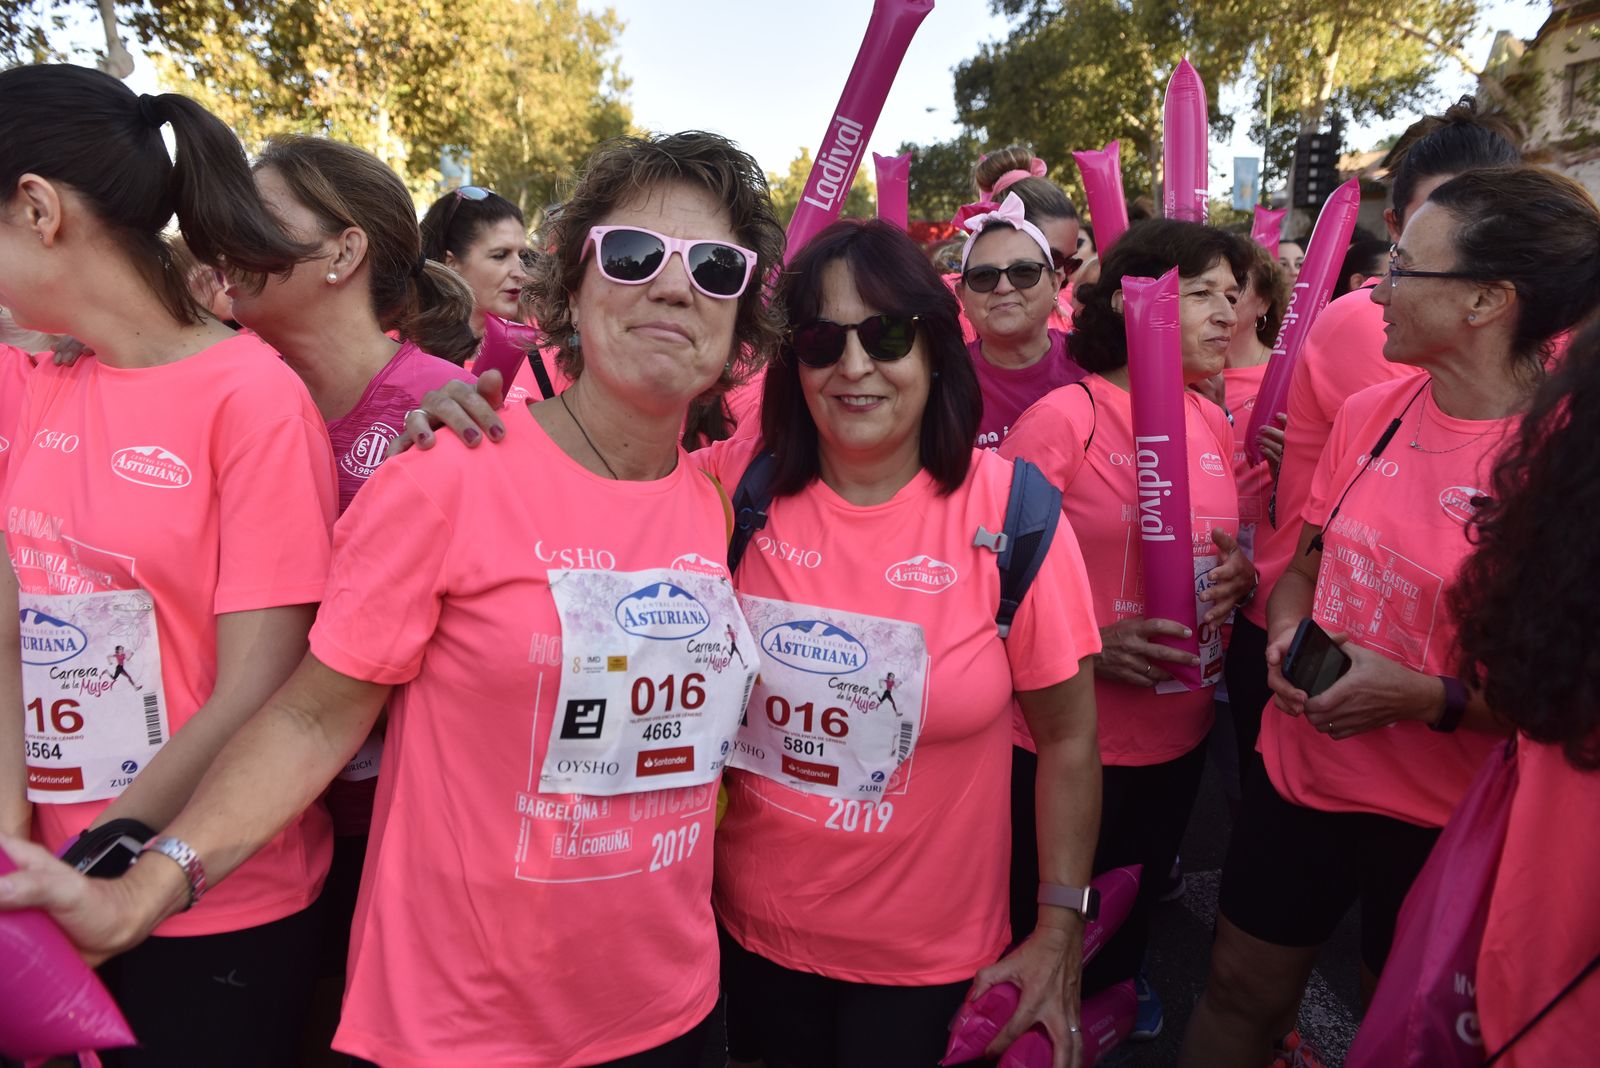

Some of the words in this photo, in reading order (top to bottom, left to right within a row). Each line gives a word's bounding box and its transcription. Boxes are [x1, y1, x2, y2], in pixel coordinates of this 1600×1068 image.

[804, 115, 863, 211] Ladival
[1272, 283, 1309, 355] Ladival
[114, 453, 183, 485] ASTURIANA
[1136, 435, 1176, 541] Ladival
[756, 536, 822, 568] OYSHO
[891, 568, 951, 585] ASTURIANA
[1337, 546, 1375, 573] VITORIA
[1383, 570, 1419, 600] GASTEIZ
[1351, 567, 1393, 599] MADRID
[624, 607, 706, 627] ASTURIANA
[1115, 601, 1144, 614] BARCE
[22, 636, 77, 652] URIANA
[529, 632, 562, 666] HO
[687, 639, 721, 653] Carrera
[769, 633, 859, 667] ASTURIANA
[50, 666, 99, 679] Carrera
[706, 654, 731, 674] Mujer
[61, 681, 70, 690] de
[72, 681, 79, 689] la
[79, 678, 116, 697] Mujer
[631, 673, 706, 717] 016
[828, 677, 870, 693] Carrera
[850, 694, 883, 714] Mujer
[27, 697, 84, 734] 16
[765, 695, 849, 739] 016
[643, 721, 681, 741] 4663
[733, 740, 765, 760] YSHO
[783, 736, 824, 757] 5801
[558, 760, 619, 775] OYSHO
[654, 756, 687, 767] Santander
[36, 775, 73, 784] Santander
[796, 766, 830, 779] Santander
[858, 785, 882, 793] ZURI
[518, 795, 598, 821] BARCELONA
[825, 798, 893, 833] 2019
[581, 829, 629, 855] CORUÑA
[649, 822, 700, 872] 2019
